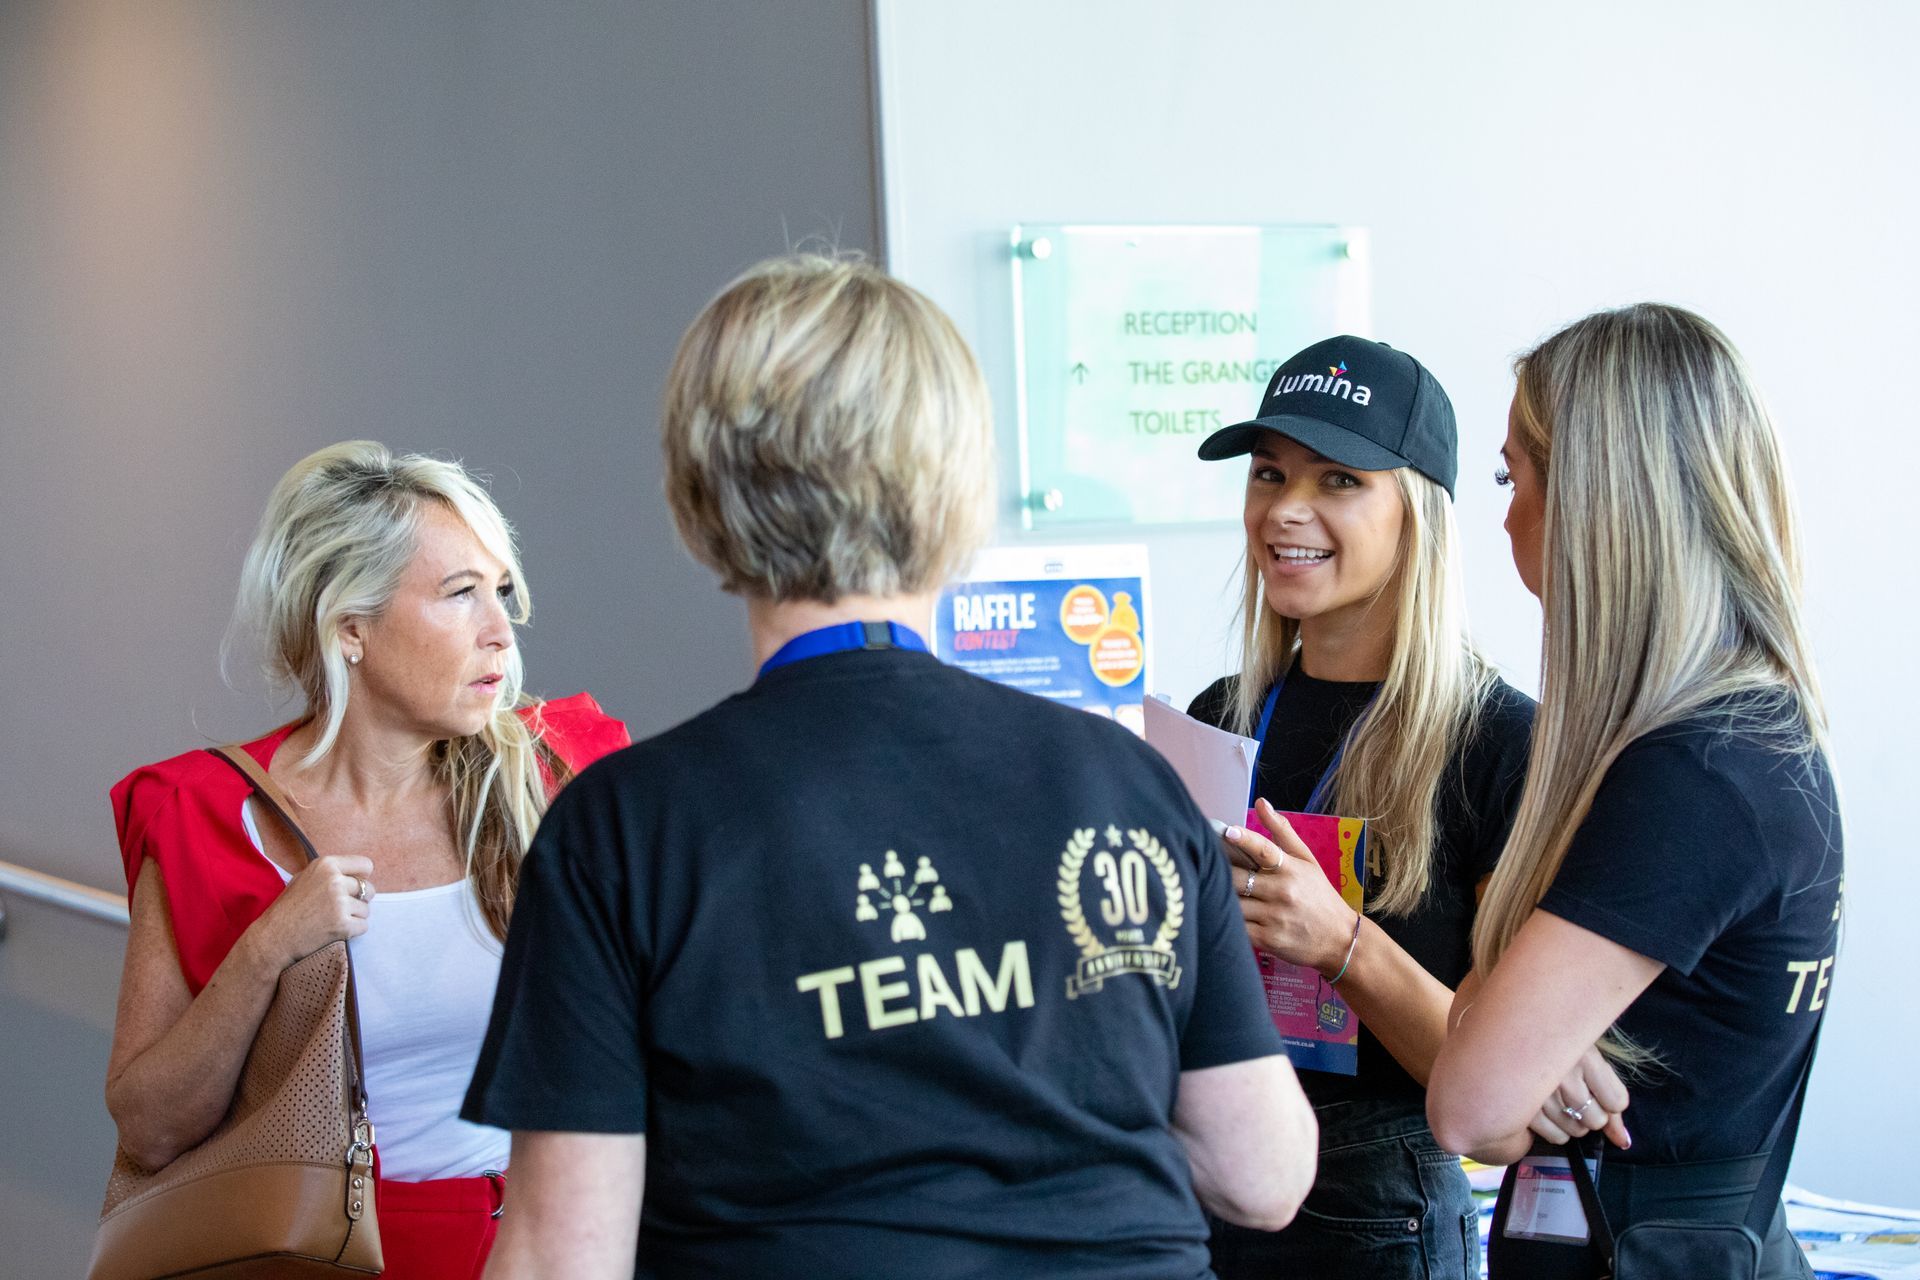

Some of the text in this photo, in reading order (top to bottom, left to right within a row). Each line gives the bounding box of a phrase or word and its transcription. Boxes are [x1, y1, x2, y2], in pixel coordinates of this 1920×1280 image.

[1124, 312, 1257, 336] RECEPTION
[1128, 361, 1174, 385] THE
[1272, 373, 1372, 406] Lumina
[1129, 410, 1223, 435] TOILETS
[953, 593, 1037, 631] RAFFLE
[954, 629, 1020, 651] CONTEST
[1094, 850, 1149, 926] 30
[796, 940, 1035, 1039] TEAM
[1321, 1002, 1346, 1020] GET
